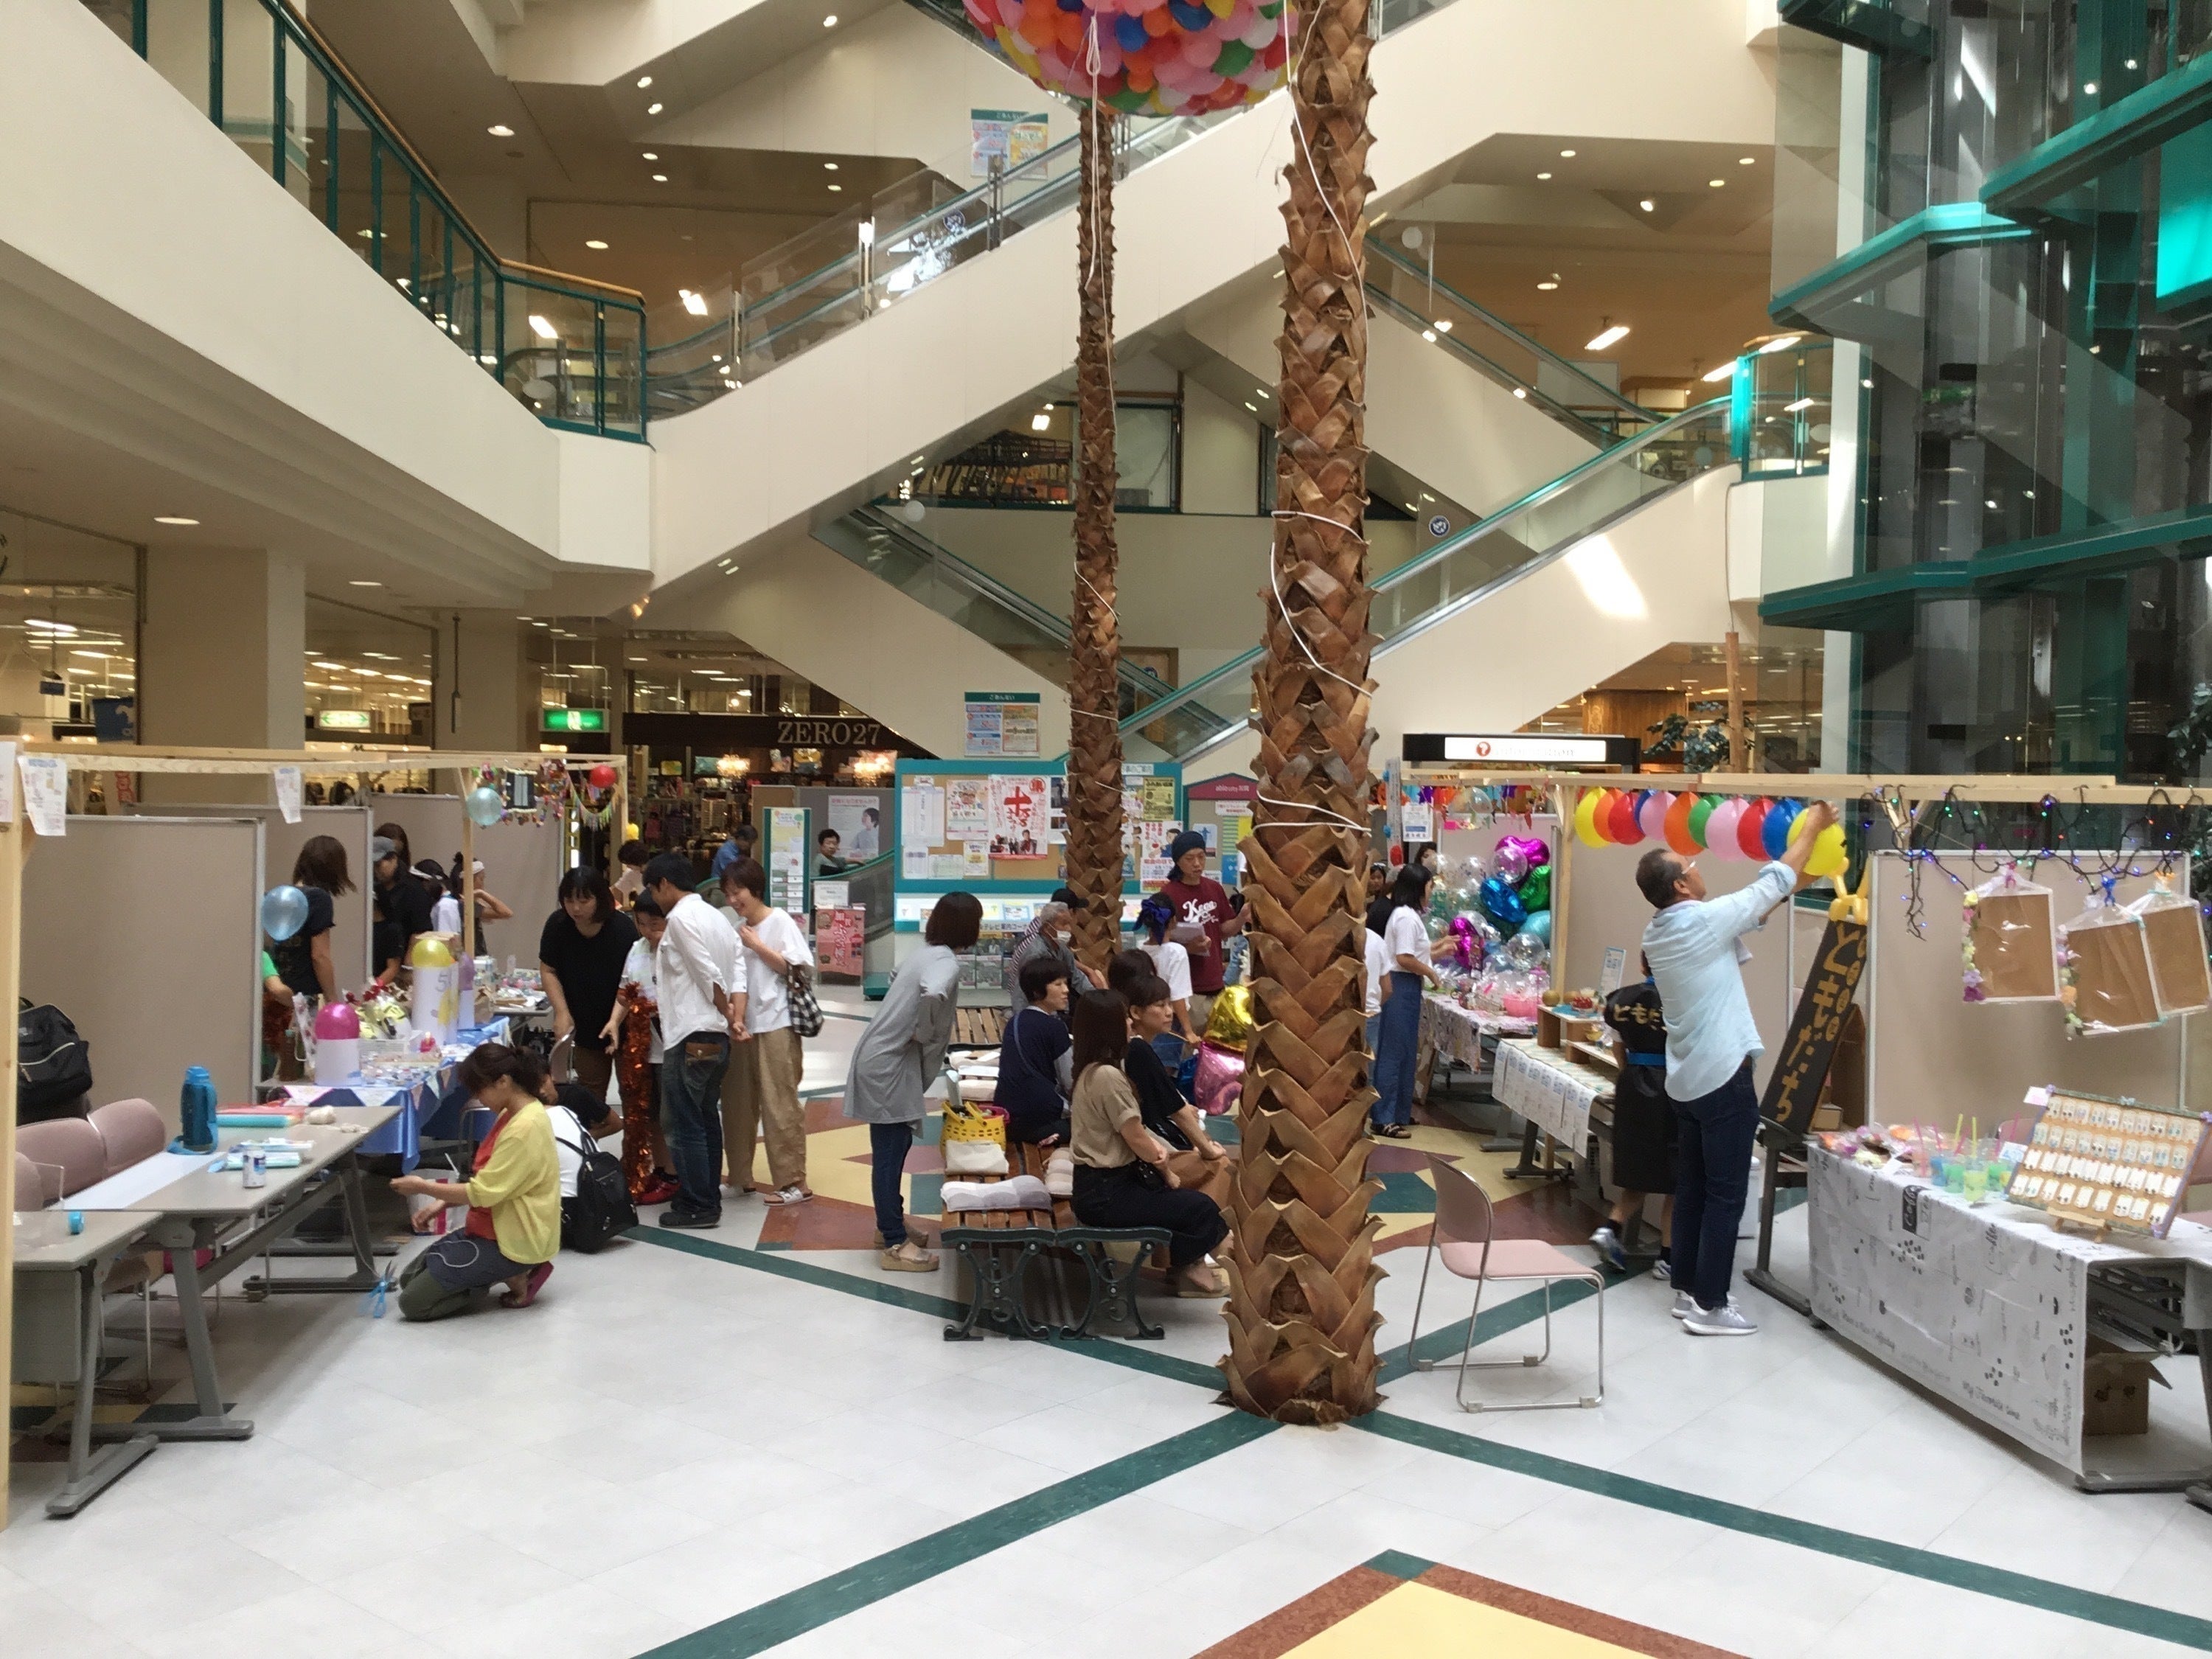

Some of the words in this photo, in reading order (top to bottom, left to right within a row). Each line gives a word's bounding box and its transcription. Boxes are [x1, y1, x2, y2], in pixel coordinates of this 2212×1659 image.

[778, 721, 881, 745] ZERO27
[1775, 922, 1861, 1122] ともだち
